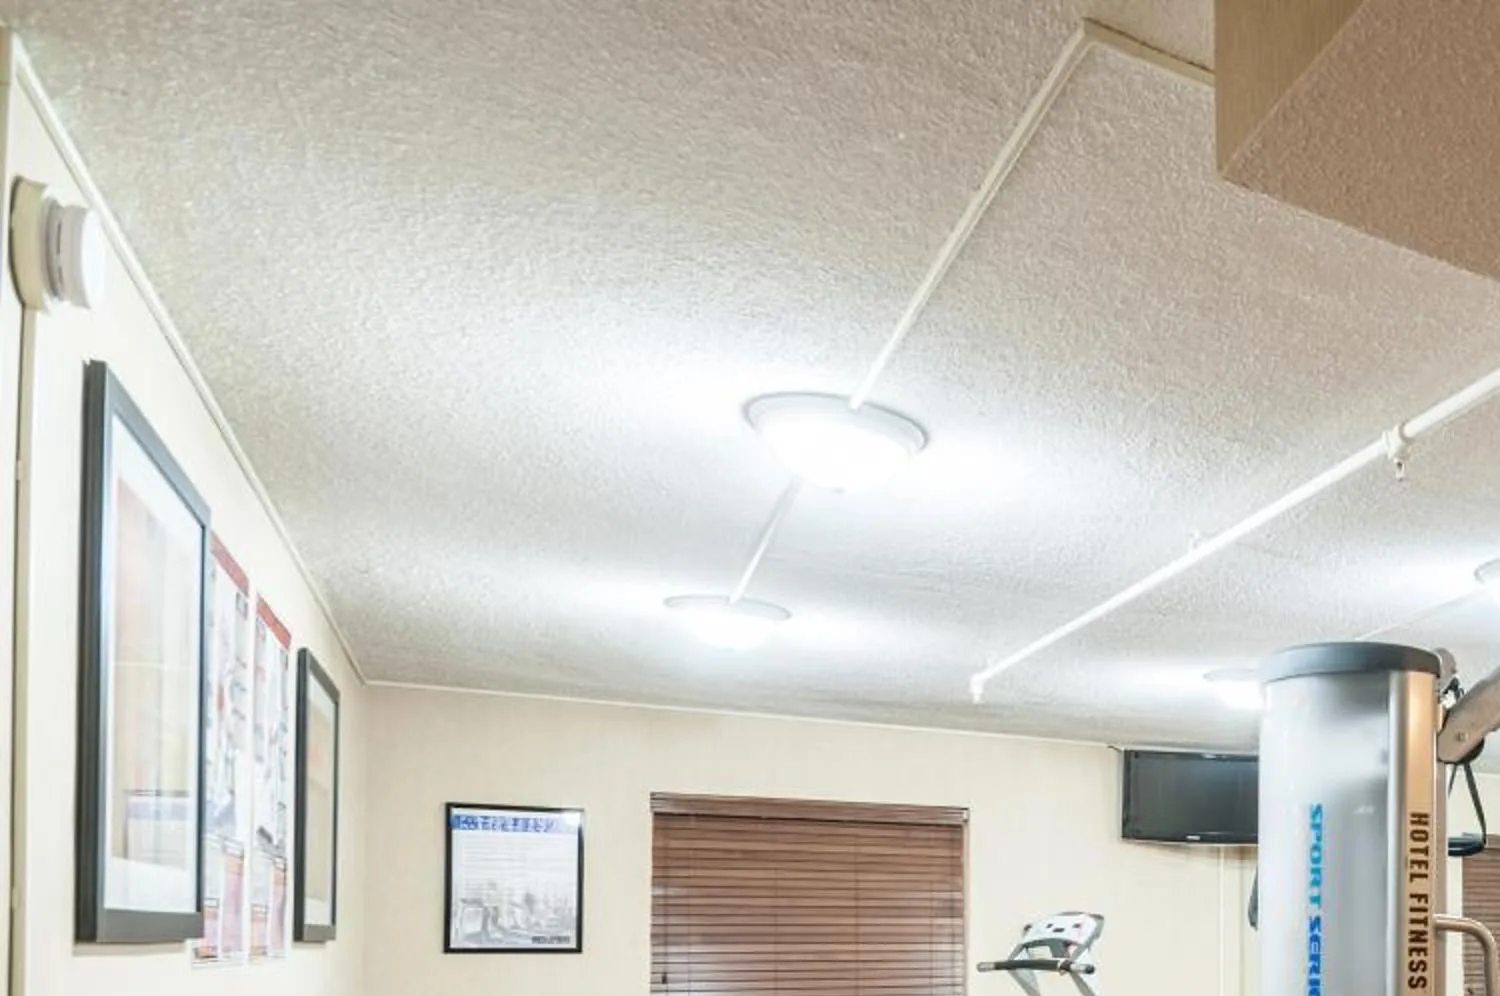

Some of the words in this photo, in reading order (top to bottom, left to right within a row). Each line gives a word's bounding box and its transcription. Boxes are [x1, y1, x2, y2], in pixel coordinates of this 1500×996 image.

[1309, 803, 1322, 907] SPORT
[1409, 812, 1429, 882] HOTEL
[1408, 894, 1428, 990] FITNESS
